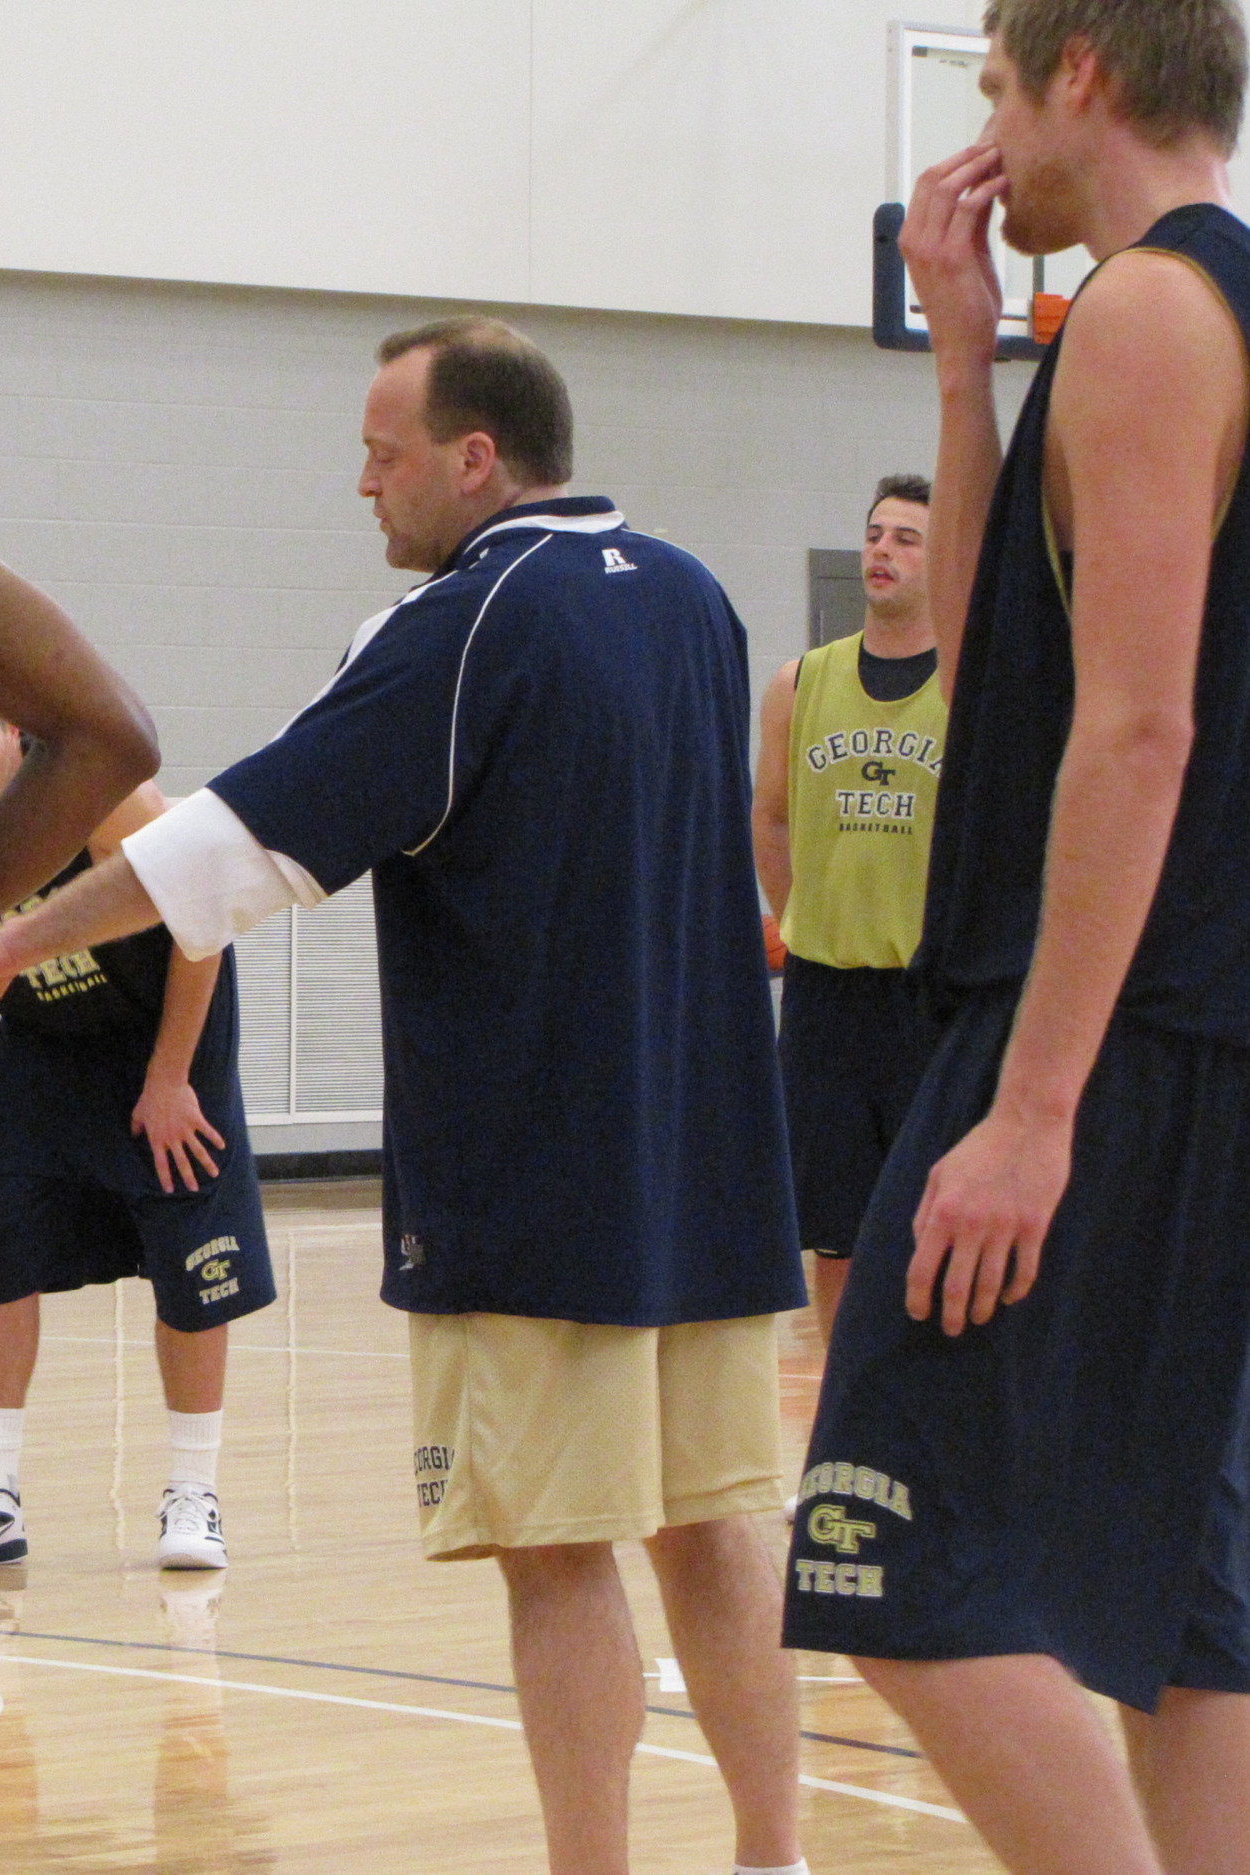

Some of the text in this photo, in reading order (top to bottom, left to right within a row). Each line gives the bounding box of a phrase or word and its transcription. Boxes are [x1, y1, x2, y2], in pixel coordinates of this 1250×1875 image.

[861, 760, 896, 786] GT
[836, 789, 916, 820] TECH
[838, 822, 913, 835] BASKETBALL
[19, 948, 101, 990] TECH
[201, 1259, 231, 1281] GT
[199, 1277, 240, 1305] TECH
[808, 1503, 877, 1554] GT
[795, 1559, 884, 1597] TECH
